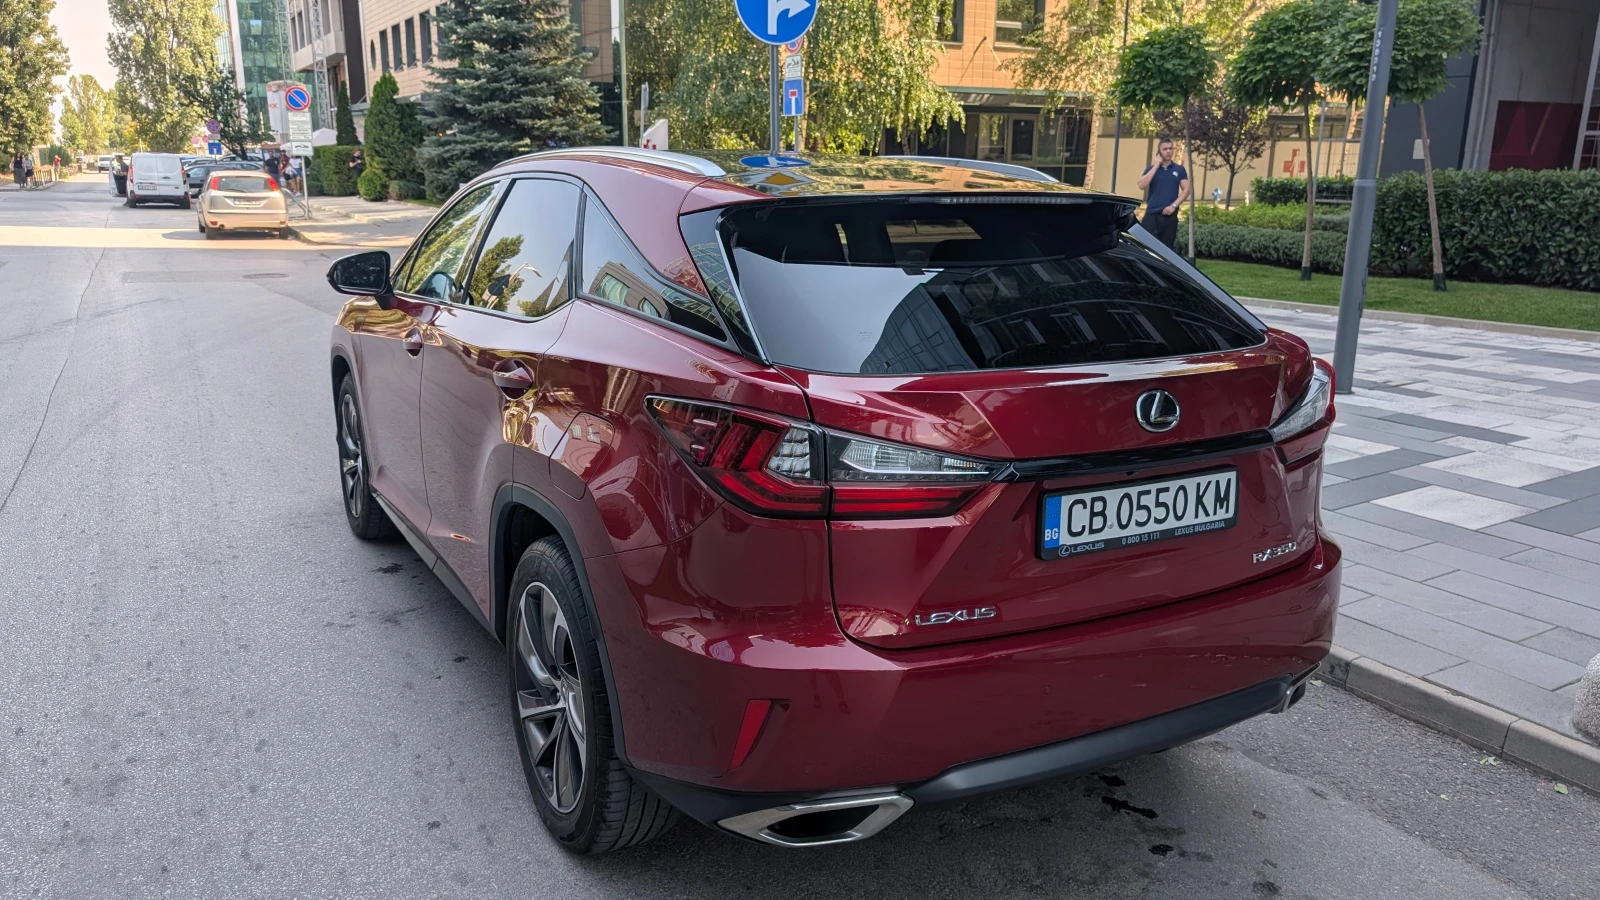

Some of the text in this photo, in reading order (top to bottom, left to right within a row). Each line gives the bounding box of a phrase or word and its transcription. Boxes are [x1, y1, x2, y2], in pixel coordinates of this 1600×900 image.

[1116, 484, 1188, 530] 0550
[1194, 477, 1232, 519] KM
[1044, 528, 1059, 541] BG
[1072, 541, 1105, 554] LEXUS
[1127, 535, 1140, 544] 800
[1141, 533, 1149, 542] 15
[1149, 532, 1160, 541] 111
[1174, 526, 1194, 536] LEXUS
[1195, 521, 1225, 533] BULGARIA
[915, 606, 996, 626] LEXUS
